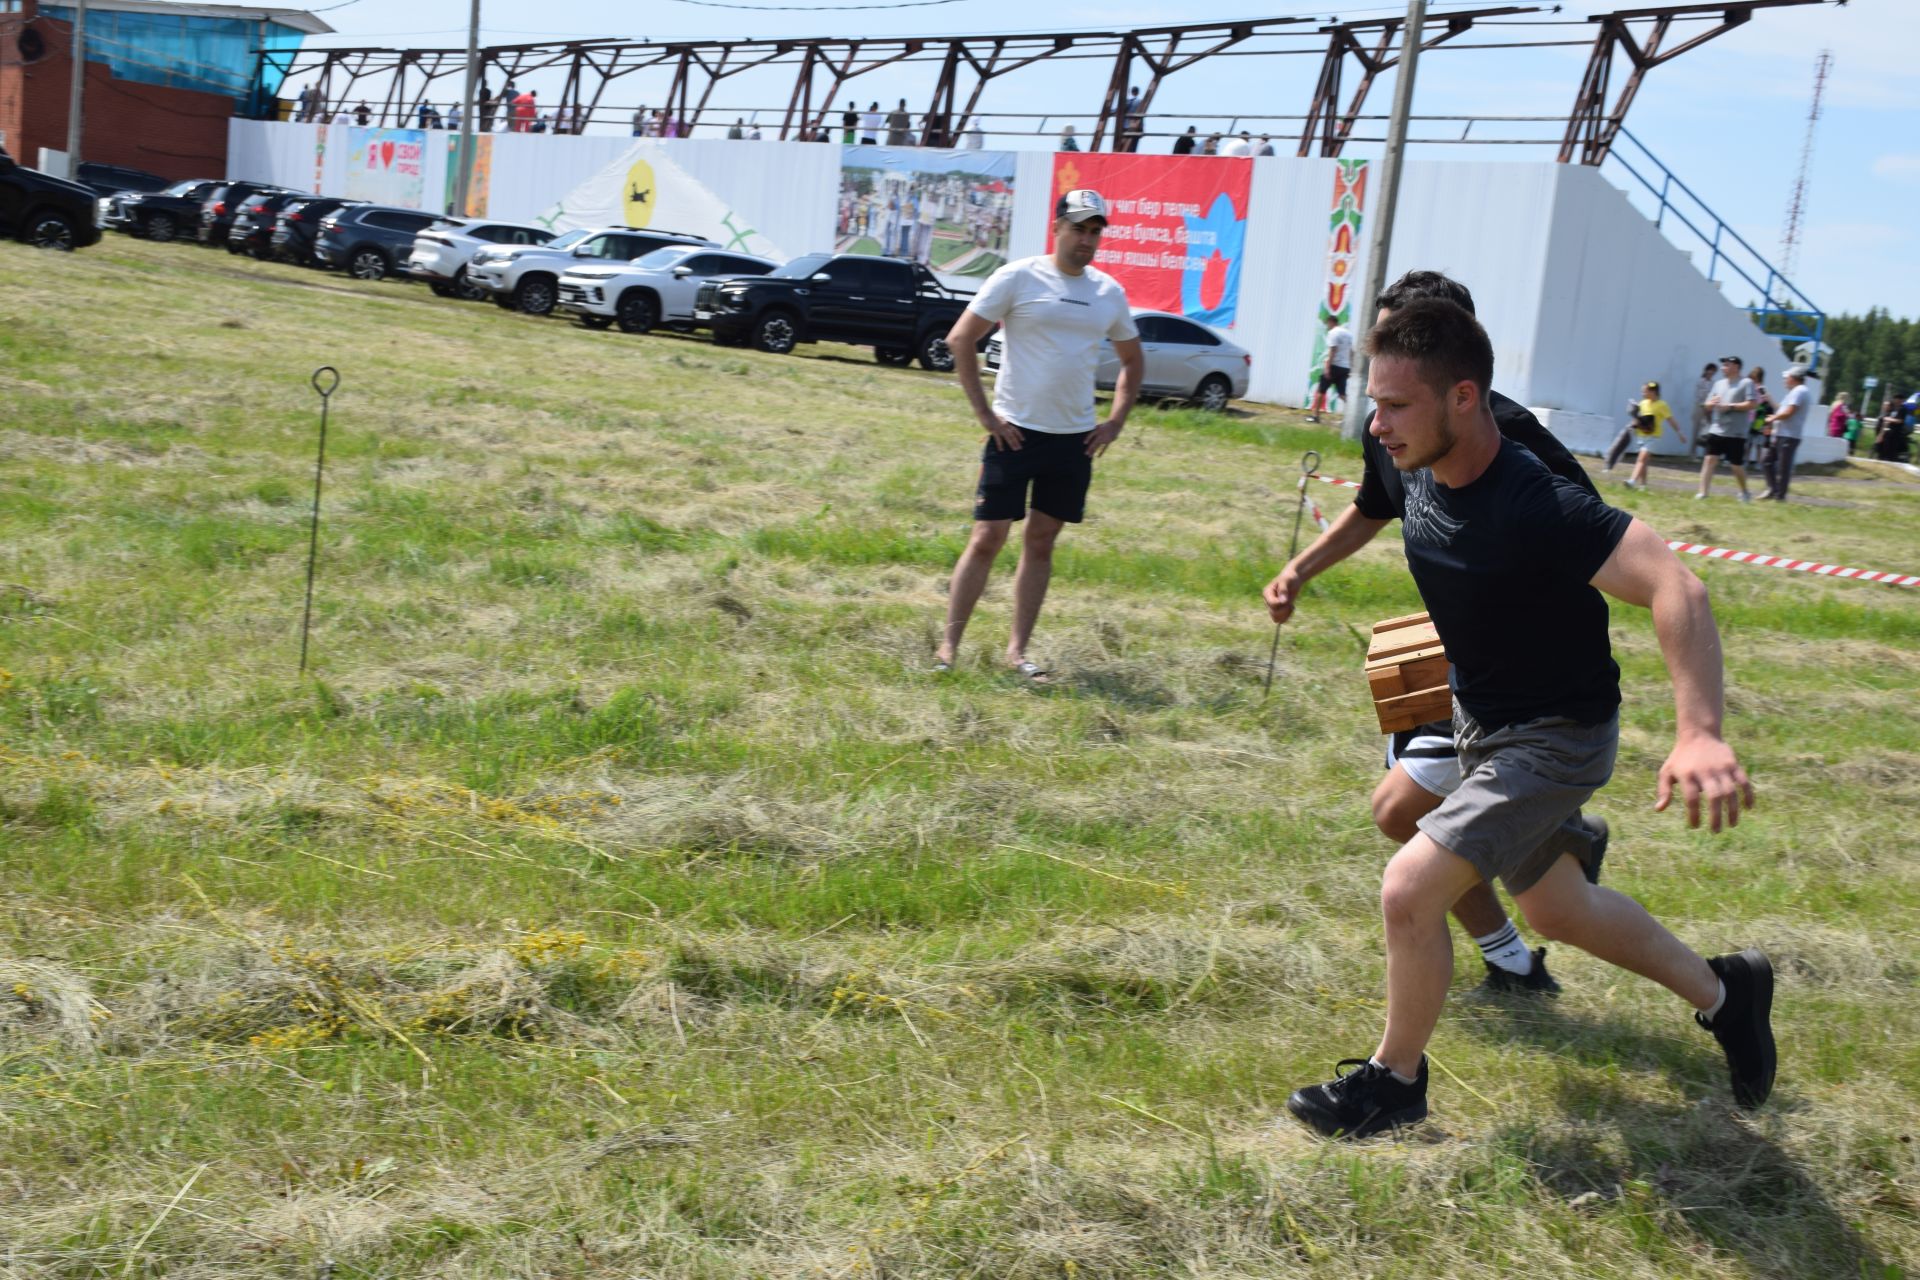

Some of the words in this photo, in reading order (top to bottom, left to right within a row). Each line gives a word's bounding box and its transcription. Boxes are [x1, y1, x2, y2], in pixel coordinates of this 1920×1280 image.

[367, 143, 378, 170] Я
[397, 140, 422, 160] СВОЙ
[397, 162, 420, 177] ГОРОД
[1115, 199, 1137, 214] чит
[1136, 197, 1162, 219] бер
[1162, 201, 1201, 217] телне
[1133, 223, 1174, 245] булса,
[1174, 226, 1217, 246] башта
[1093, 249, 1123, 264] елен
[1160, 251, 1208, 272] белсен
